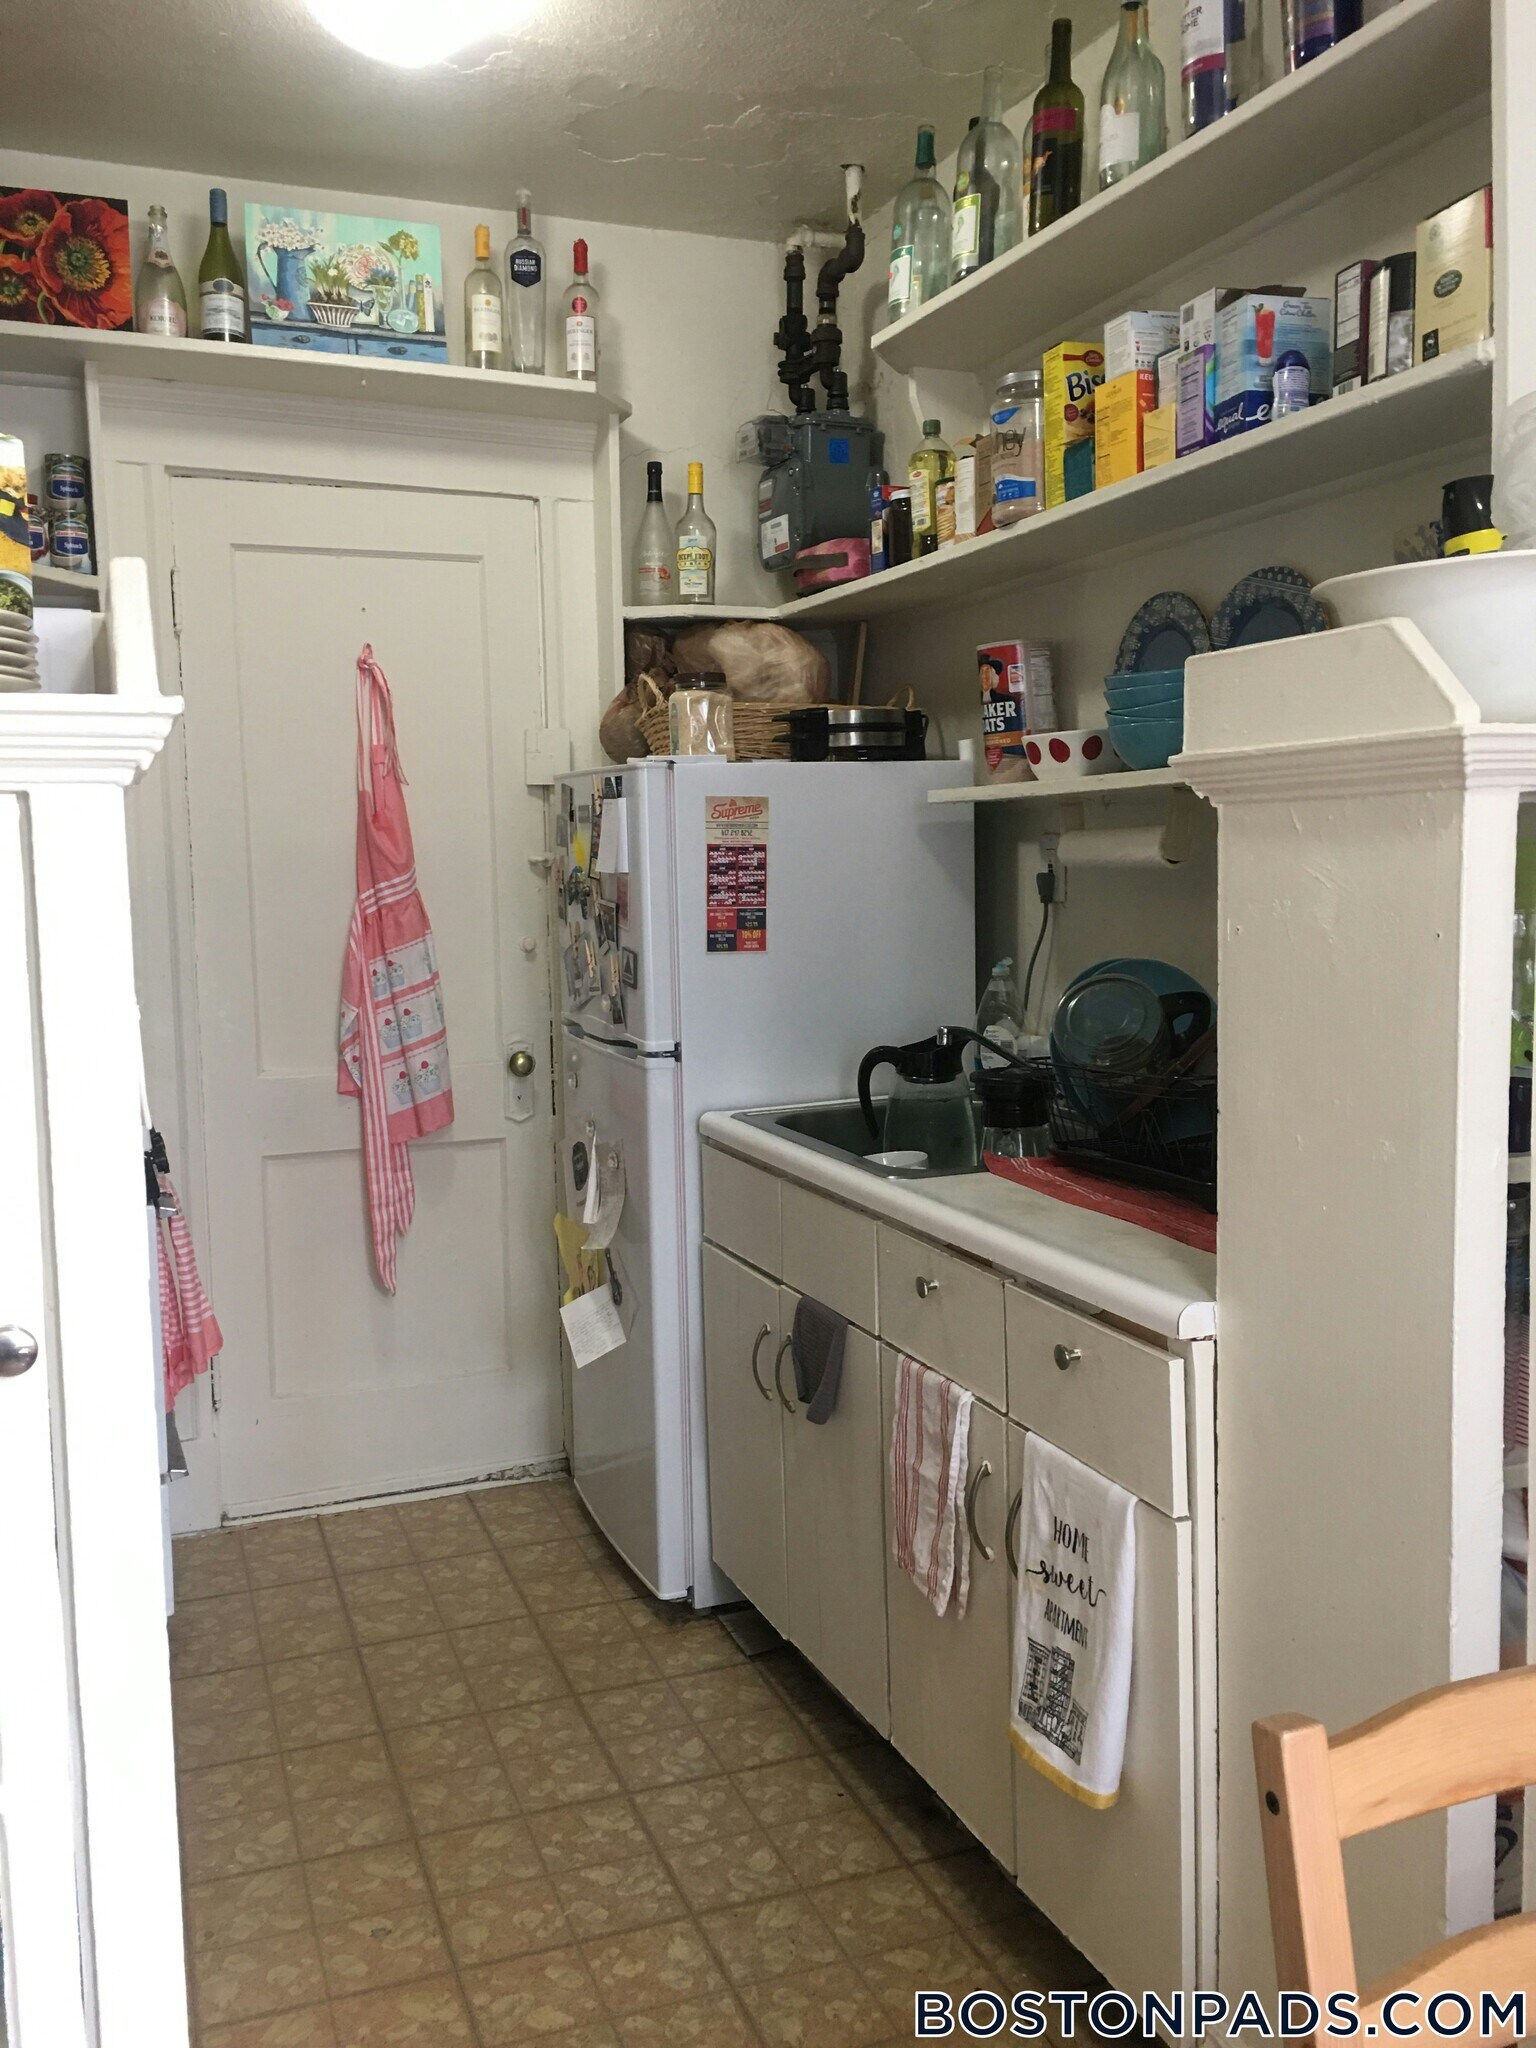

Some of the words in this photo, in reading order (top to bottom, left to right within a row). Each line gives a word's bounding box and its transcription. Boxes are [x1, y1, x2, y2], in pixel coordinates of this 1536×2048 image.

[513, 264, 538, 272] DIAMOND
[1215, 402, 1244, 433] equal
[1246, 404, 1270, 421] e
[711, 803, 763, 820] Supreme
[1053, 1516, 1089, 1564] HOME
[1025, 1559, 1107, 1608] sweet
[1043, 1597, 1089, 1650] APARTMENT
